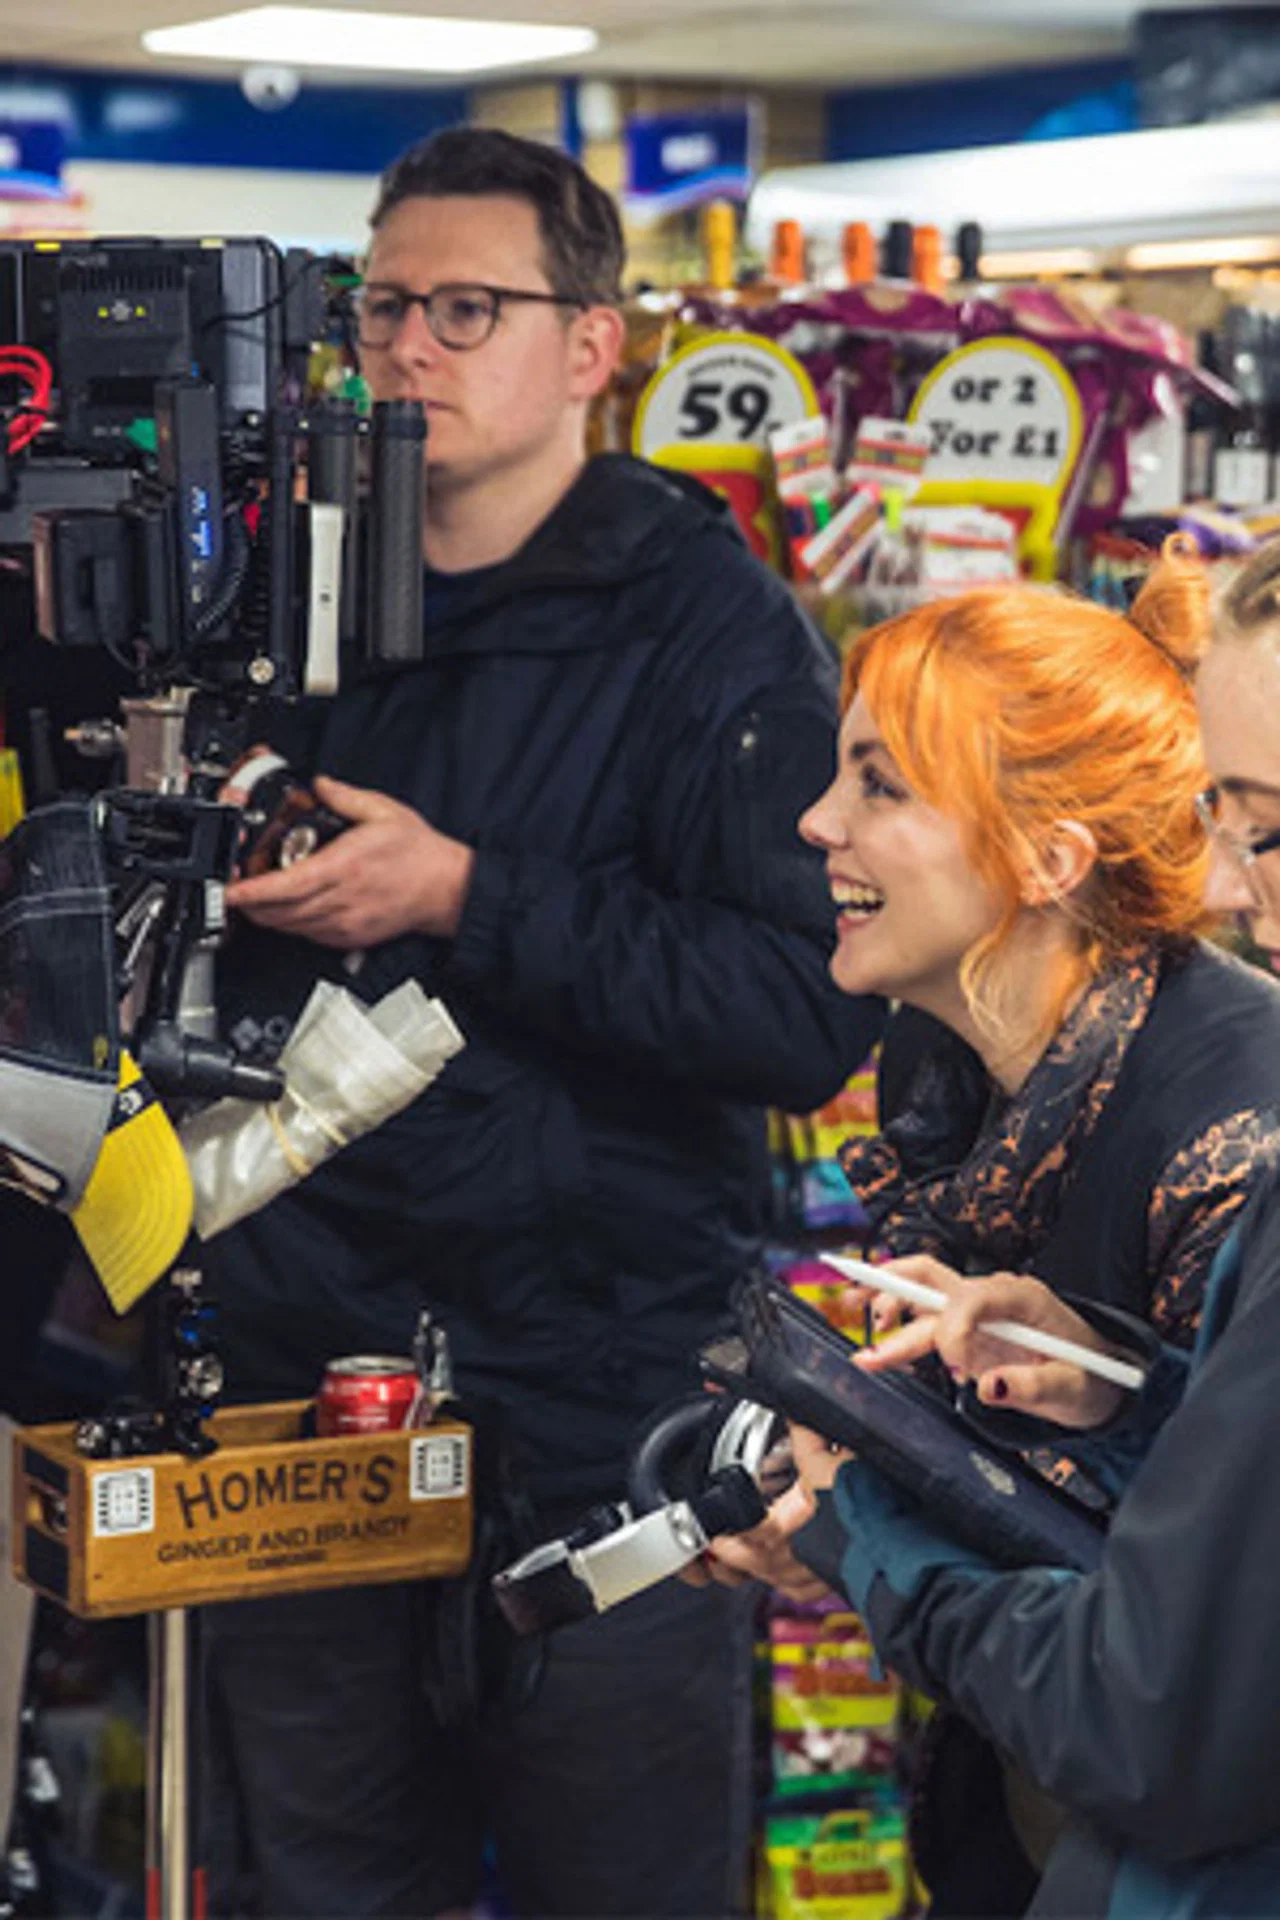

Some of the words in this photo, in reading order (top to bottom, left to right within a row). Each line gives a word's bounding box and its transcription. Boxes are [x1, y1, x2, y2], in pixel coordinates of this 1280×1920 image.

[676, 383, 783, 440] 59
[952, 376, 1001, 403] or
[1012, 375, 1036, 404] 2
[1011, 425, 1057, 458] £1
[175, 1455, 397, 1529] HOMER'S
[157, 1533, 252, 1564] GINGER
[257, 1527, 309, 1551] AND
[315, 1514, 412, 1545] BRANDY
